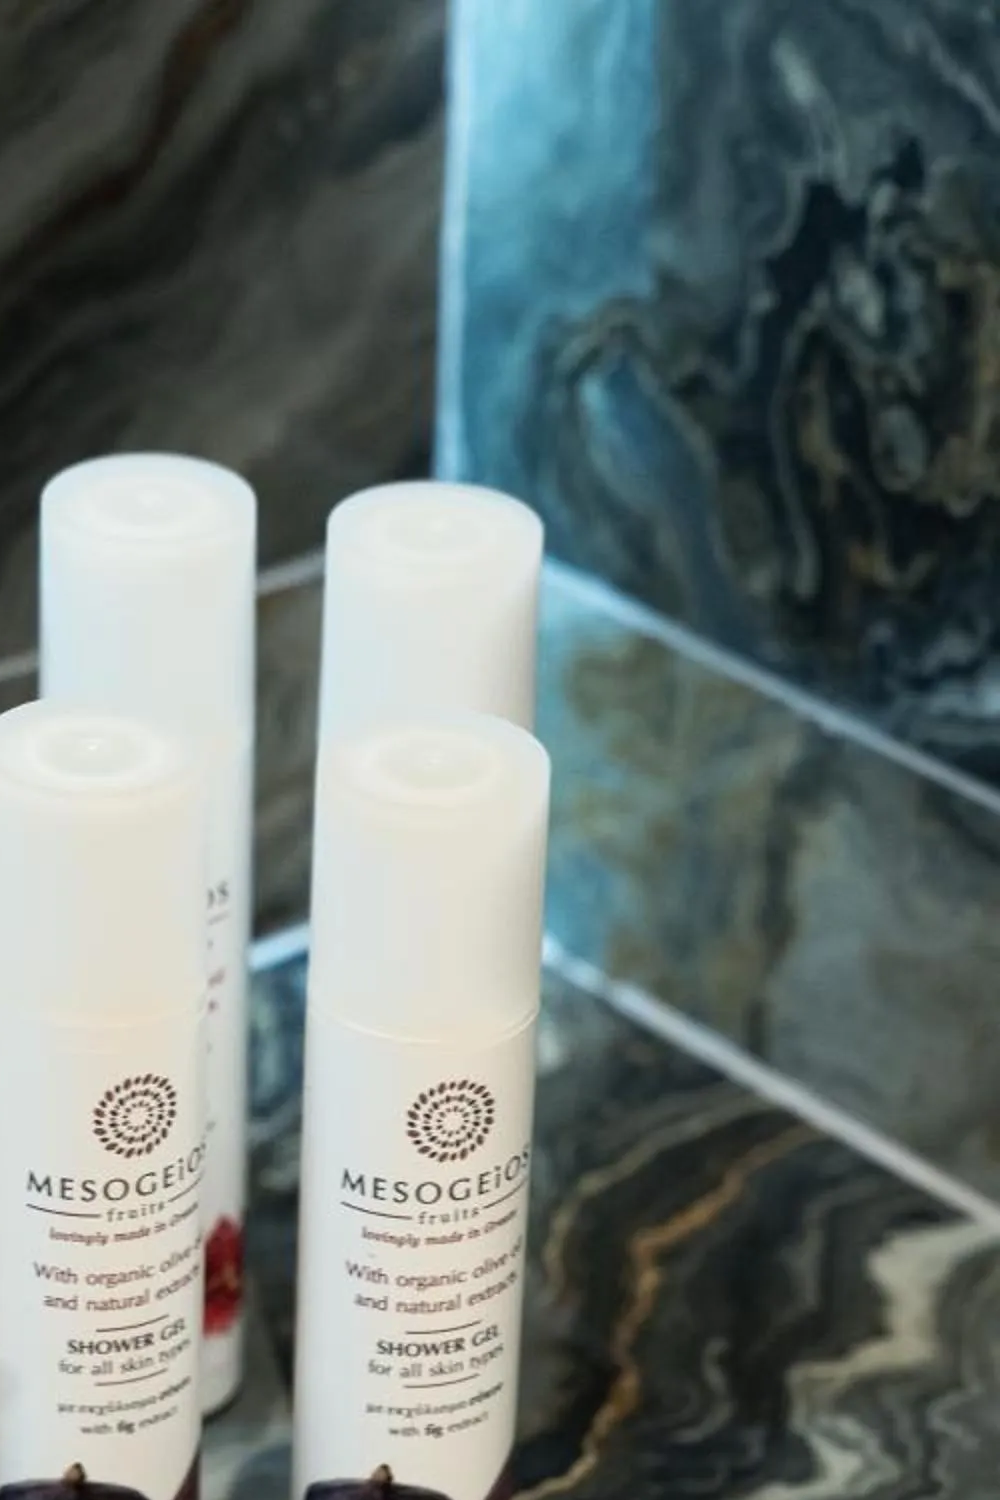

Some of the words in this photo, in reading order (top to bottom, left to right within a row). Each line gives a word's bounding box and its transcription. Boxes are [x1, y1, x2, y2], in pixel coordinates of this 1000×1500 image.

[106, 1201, 165, 1222] fruits
[418, 1207, 480, 1225] fruits
[32, 1260, 78, 1284] With
[85, 1264, 155, 1289] organic
[159, 1246, 191, 1273] olive
[345, 1259, 388, 1285] With
[395, 1269, 468, 1291] organic
[472, 1252, 508, 1279] olive
[43, 1295, 78, 1311] and
[86, 1288, 150, 1311] natural
[354, 1293, 388, 1311] and
[395, 1293, 461, 1314] natural
[66, 1333, 155, 1355] SHOWER
[160, 1318, 186, 1341] GEL
[376, 1337, 466, 1358] SHOWER
[471, 1324, 500, 1347] GEL
[58, 1359, 83, 1374] for
[91, 1360, 113, 1375] all
[120, 1357, 154, 1373] skin
[368, 1359, 391, 1376] for
[400, 1363, 422, 1378] all
[429, 1361, 464, 1377] skin
[117, 1420, 136, 1434] fig
[424, 1424, 444, 1438] fig
